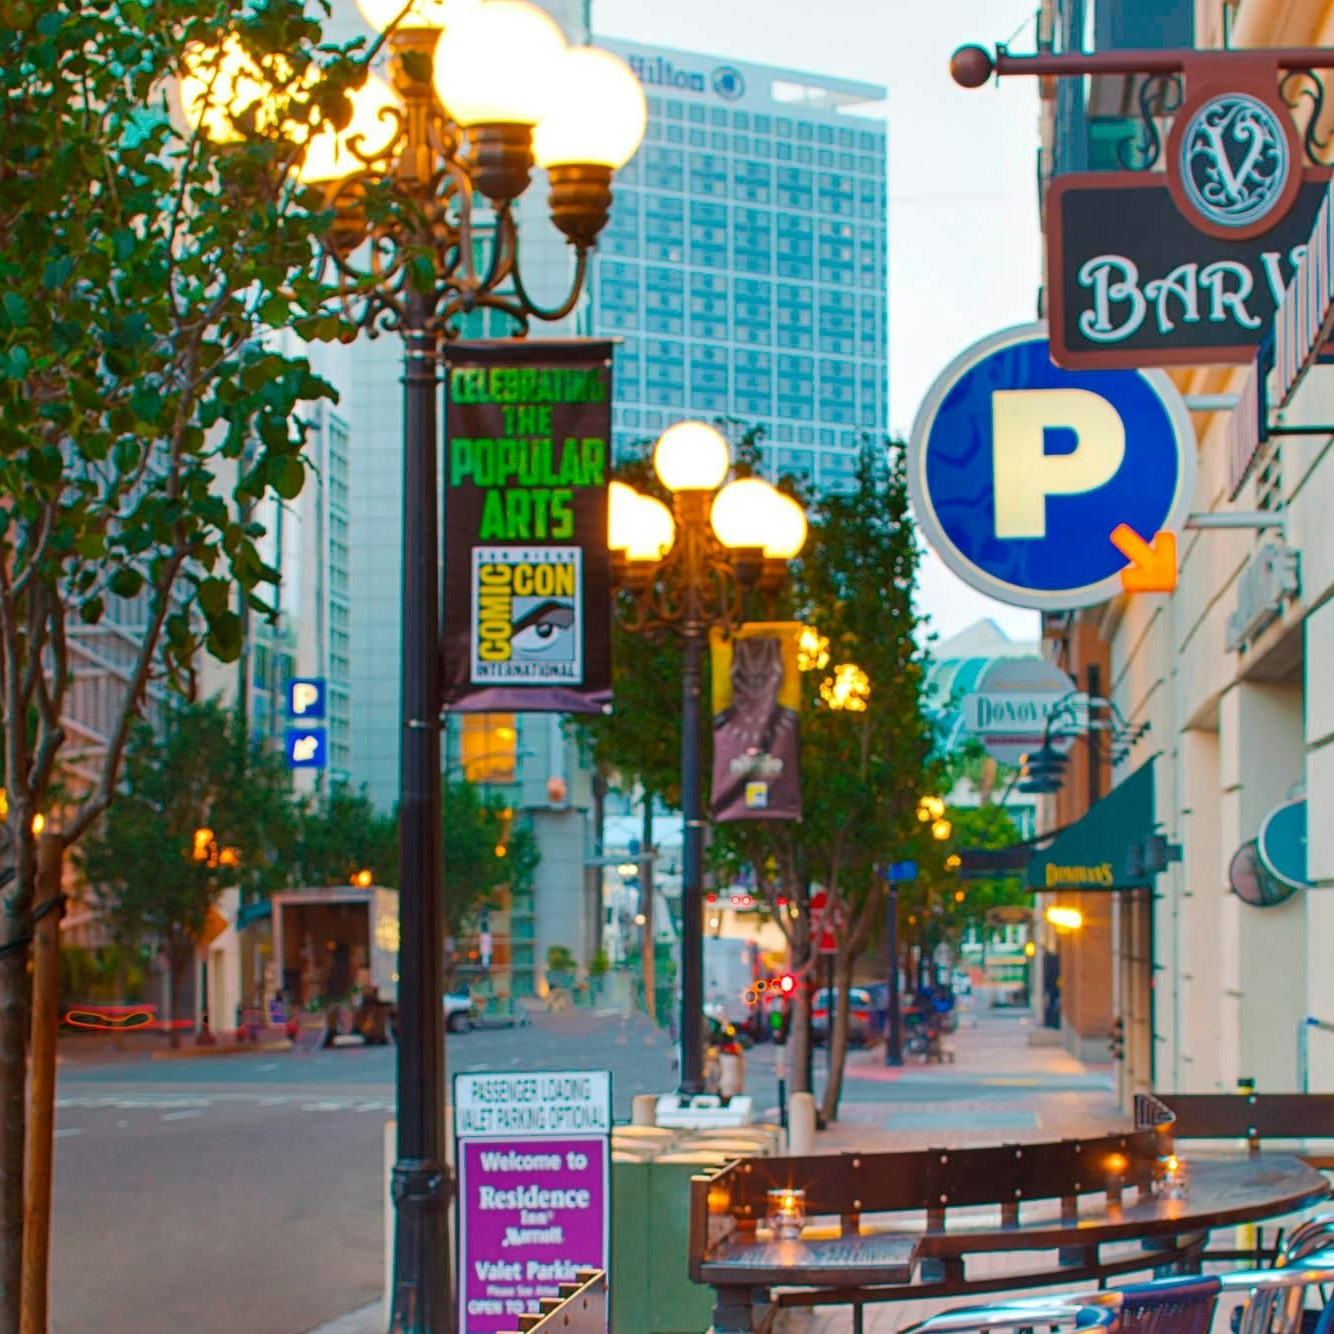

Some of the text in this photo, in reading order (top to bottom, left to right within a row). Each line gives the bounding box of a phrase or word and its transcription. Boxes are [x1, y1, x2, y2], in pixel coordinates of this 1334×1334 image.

[628, 55, 705, 92] Hilton
[450, 367, 605, 403] CELEBRATING
[502, 406, 553, 435] THE
[450, 438, 605, 487] POPULAR
[992, 388, 1126, 538] P
[479, 488, 574, 540] ARTS
[512, 562, 576, 597] CON
[479, 563, 513, 661] COMIC
[293, 683, 318, 714] P
[471, 1077, 591, 1103] PASSENGER LOADING
[462, 1105, 606, 1131] VALET PARKING OPTIONAL
[480, 1151, 588, 1172] Welcome to
[479, 1185, 590, 1210] Residence
[475, 1259, 523, 1281] Valet
[467, 1300, 504, 1315] OPEN
[505, 1300, 525, 1315] TO
